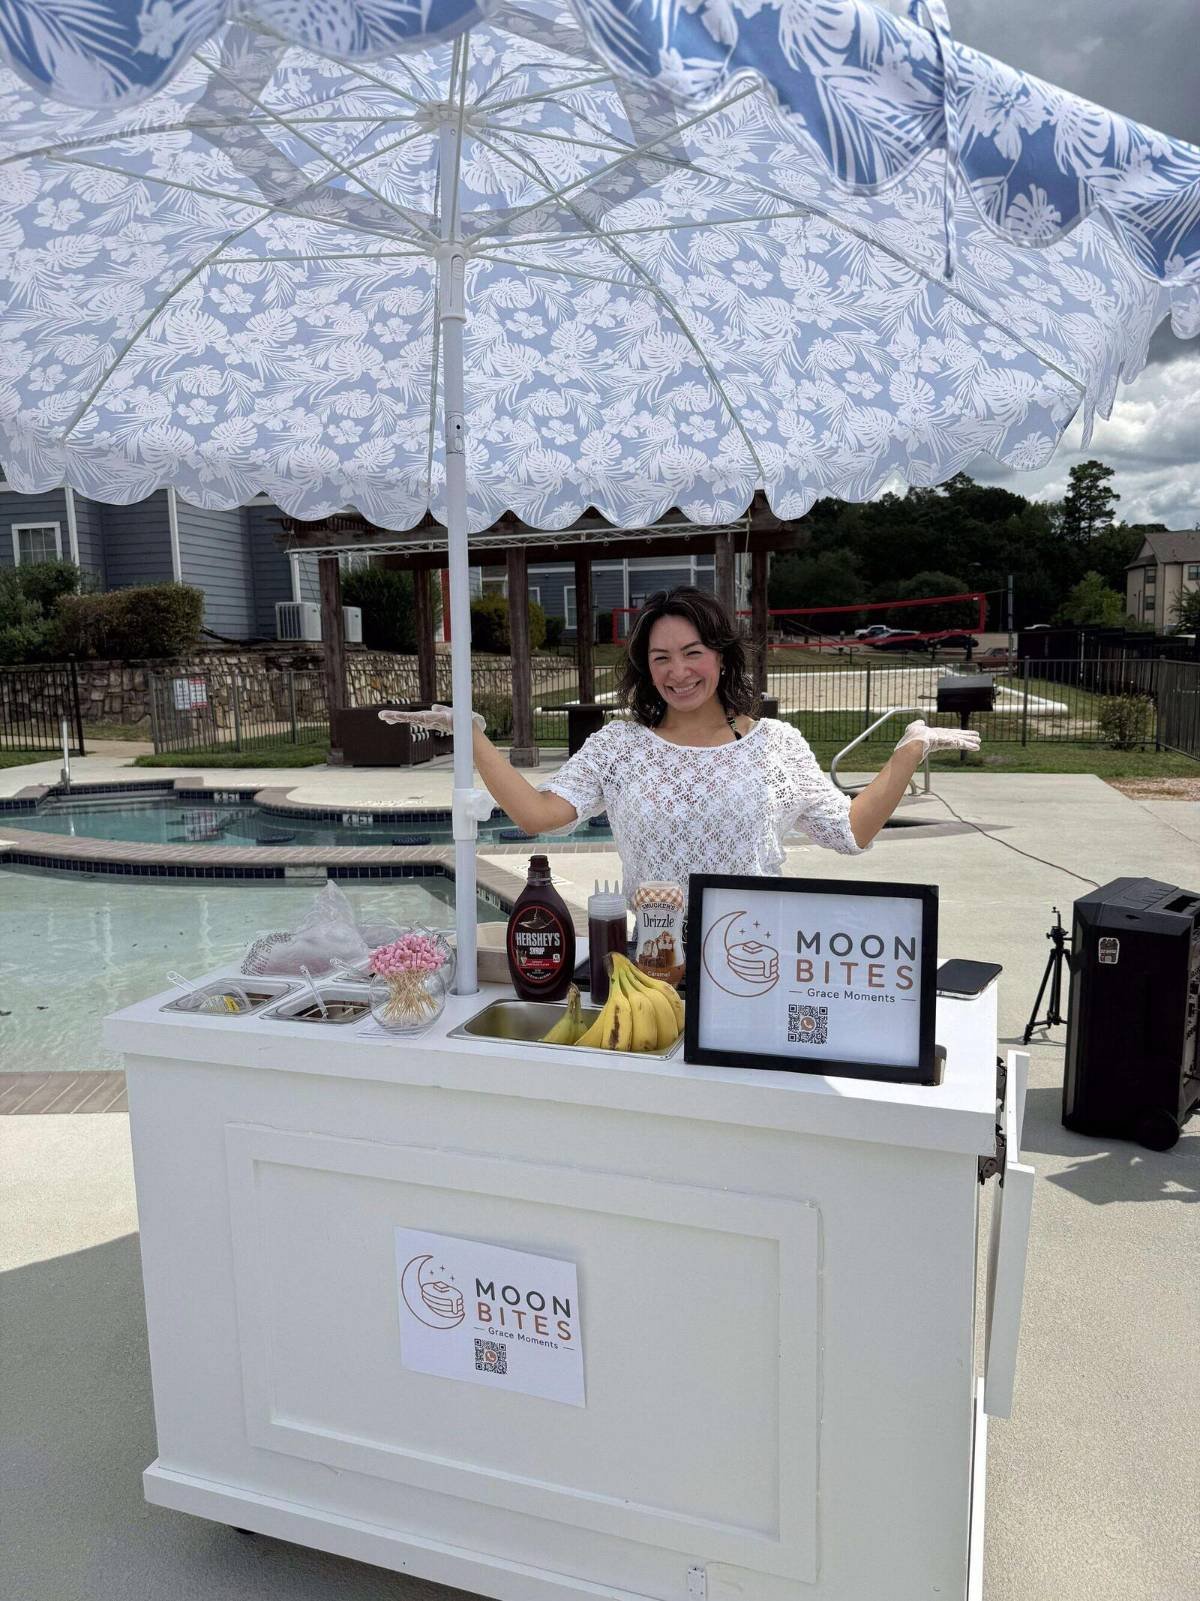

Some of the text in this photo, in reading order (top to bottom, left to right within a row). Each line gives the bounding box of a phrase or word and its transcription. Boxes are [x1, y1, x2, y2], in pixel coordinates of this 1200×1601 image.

[641, 902, 676, 911] SMUCKER'S
[643, 913, 675, 928] Drizzle
[516, 932, 561, 947] HERSHEY'S
[797, 930, 916, 961] MOON
[796, 959, 914, 990] BITES
[807, 988, 896, 1003] Grace Moments
[475, 1278, 571, 1318] MOON
[477, 1302, 572, 1341] BITES
[488, 1327, 559, 1350] Grace Moments
